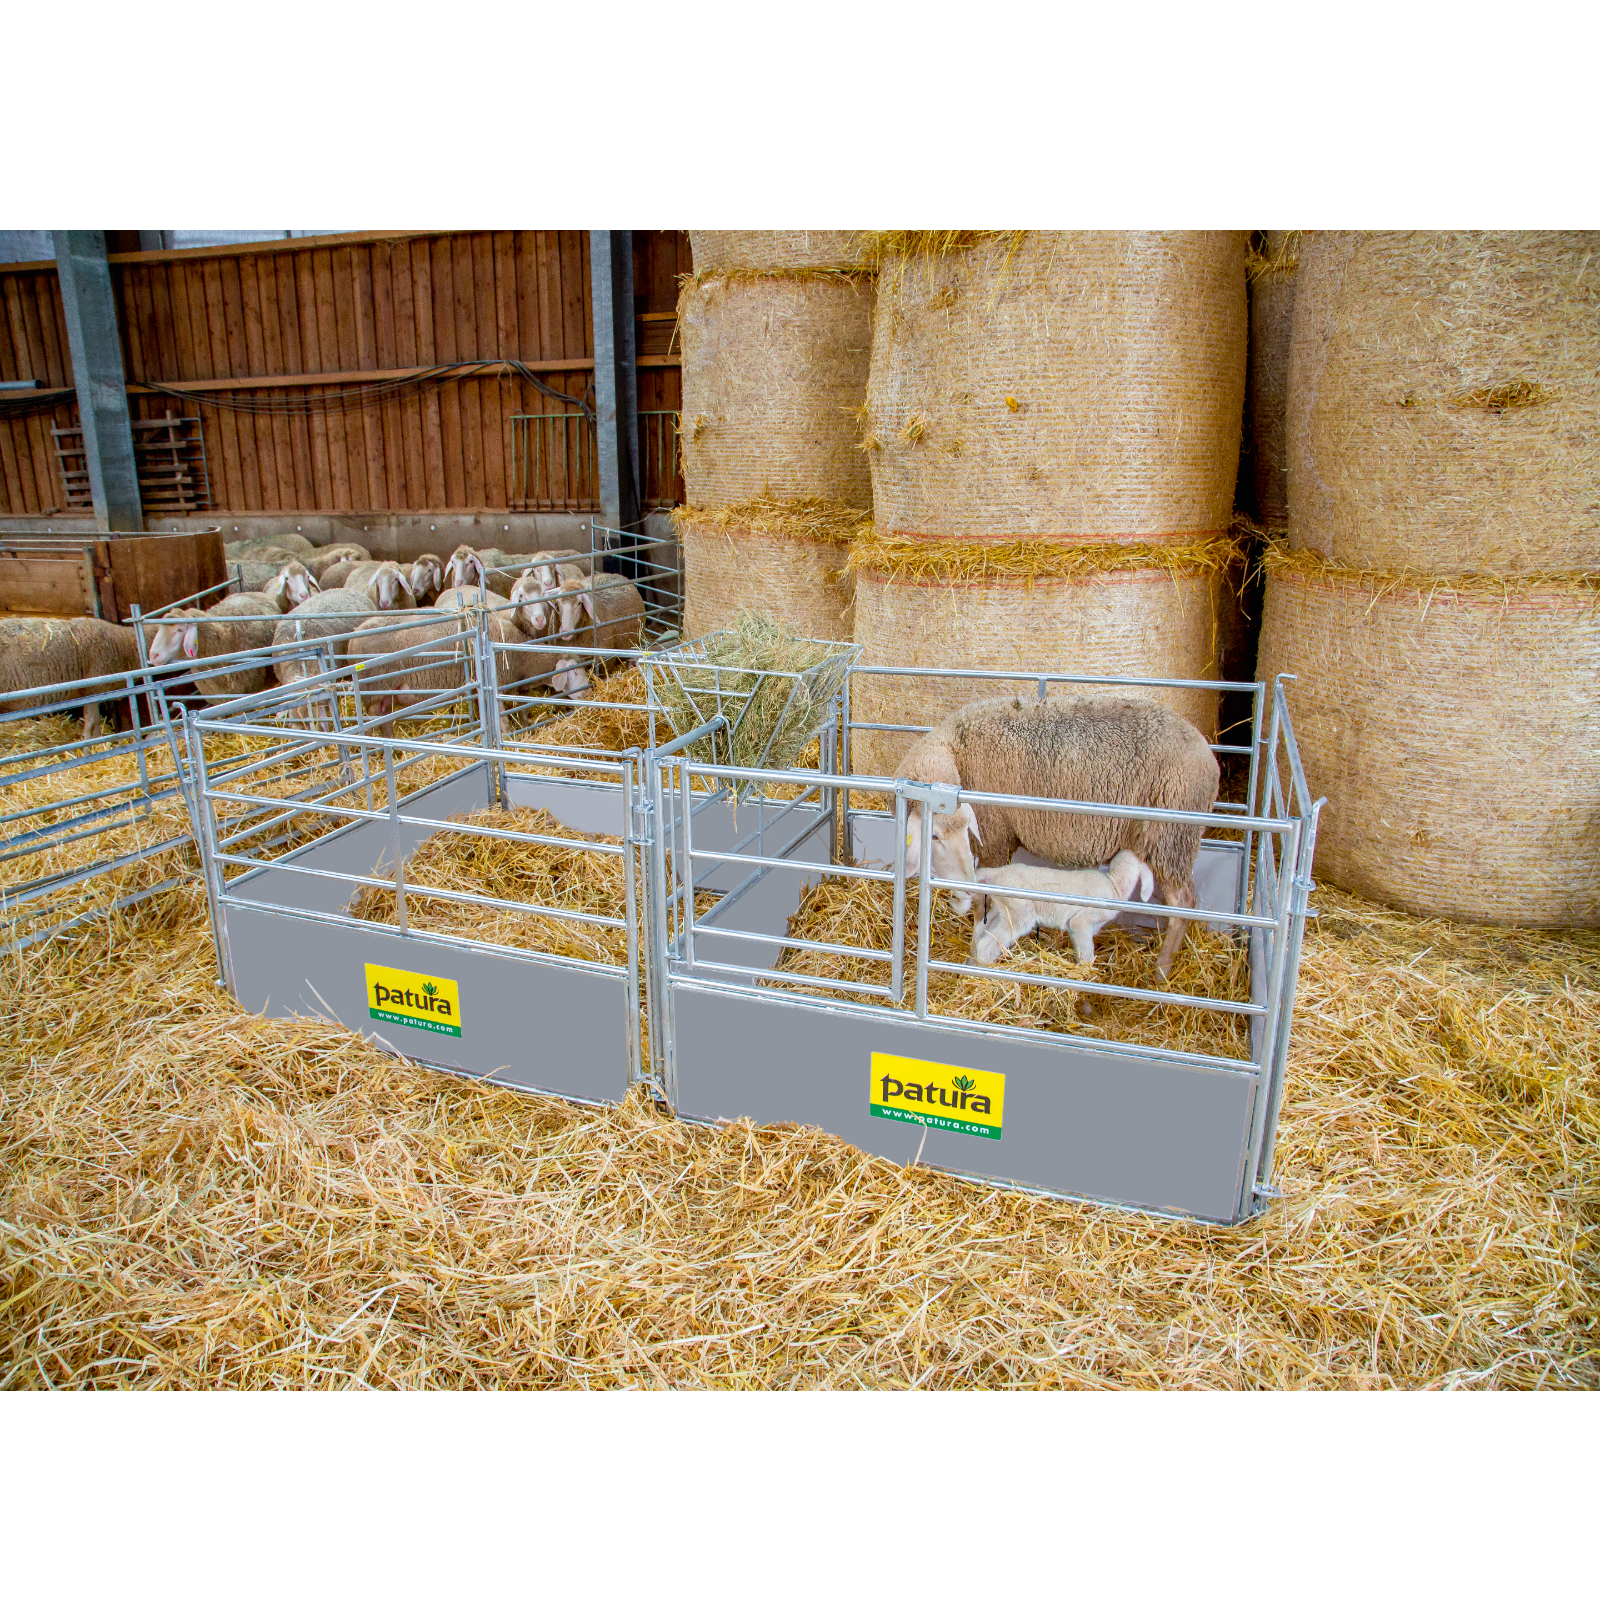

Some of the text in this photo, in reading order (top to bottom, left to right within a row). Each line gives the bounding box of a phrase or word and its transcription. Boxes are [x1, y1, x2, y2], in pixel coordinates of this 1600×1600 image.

[373, 982, 452, 1016] patura
[378, 1011, 453, 1033] www.patura.com
[880, 1073, 991, 1115] patura
[882, 1108, 990, 1135] www.patura.com
